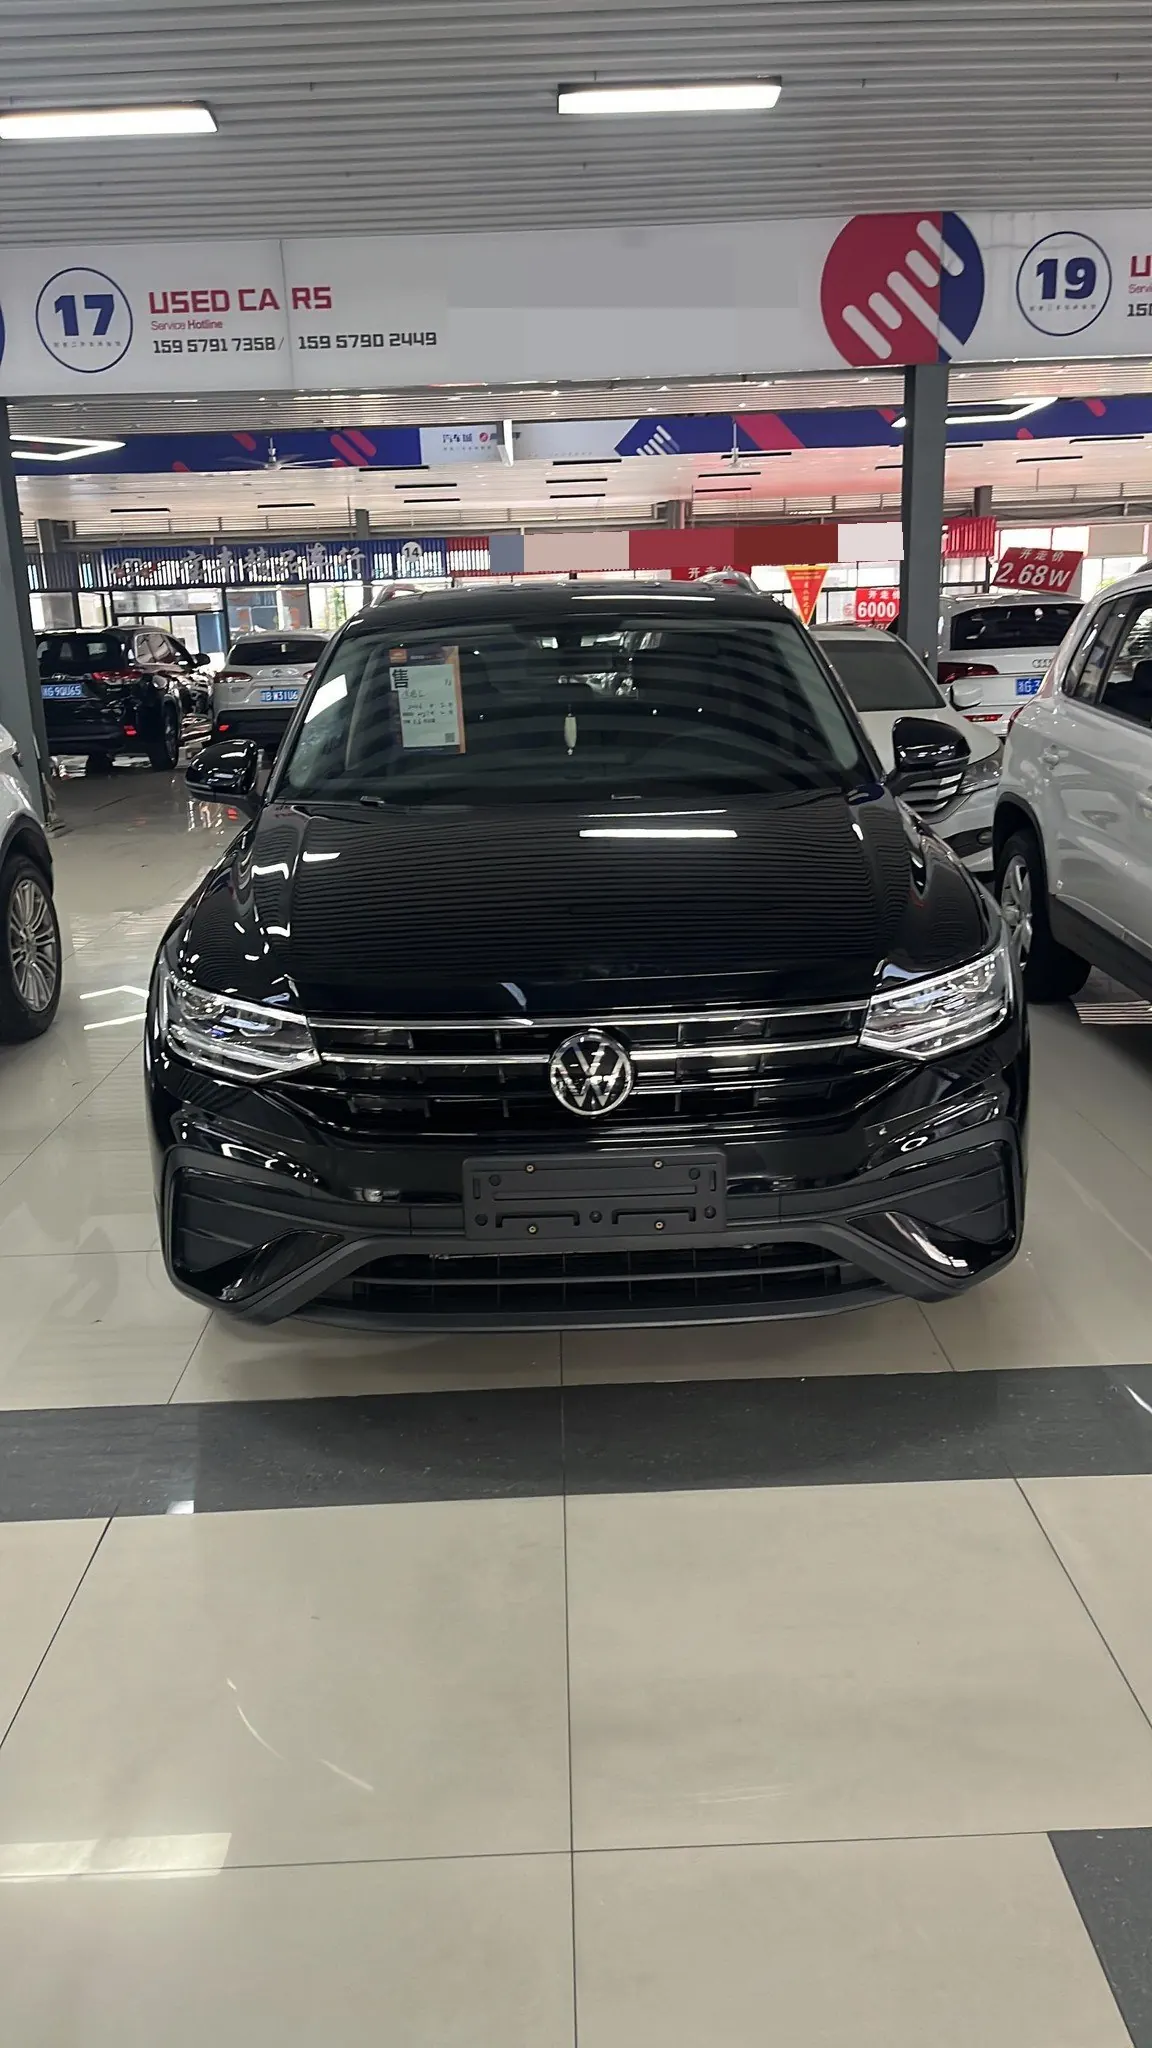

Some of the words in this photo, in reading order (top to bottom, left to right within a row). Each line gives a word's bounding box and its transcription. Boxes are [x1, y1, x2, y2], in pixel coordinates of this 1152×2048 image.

[1035, 256, 1097, 300] 19
[148, 289, 231, 315] USED
[54, 294, 115, 337] 17
[150, 319, 187, 332] Service
[187, 318, 225, 330] Hotline
[153, 338, 183, 354] 159
[186, 337, 228, 353] 5791
[298, 335, 331, 350] 159
[335, 333, 384, 349] 5790
[389, 331, 437, 347] 2449
[404, 546, 420, 558] 14
[857, 601, 897, 618] 6000
[391, 668, 409, 689] 售
